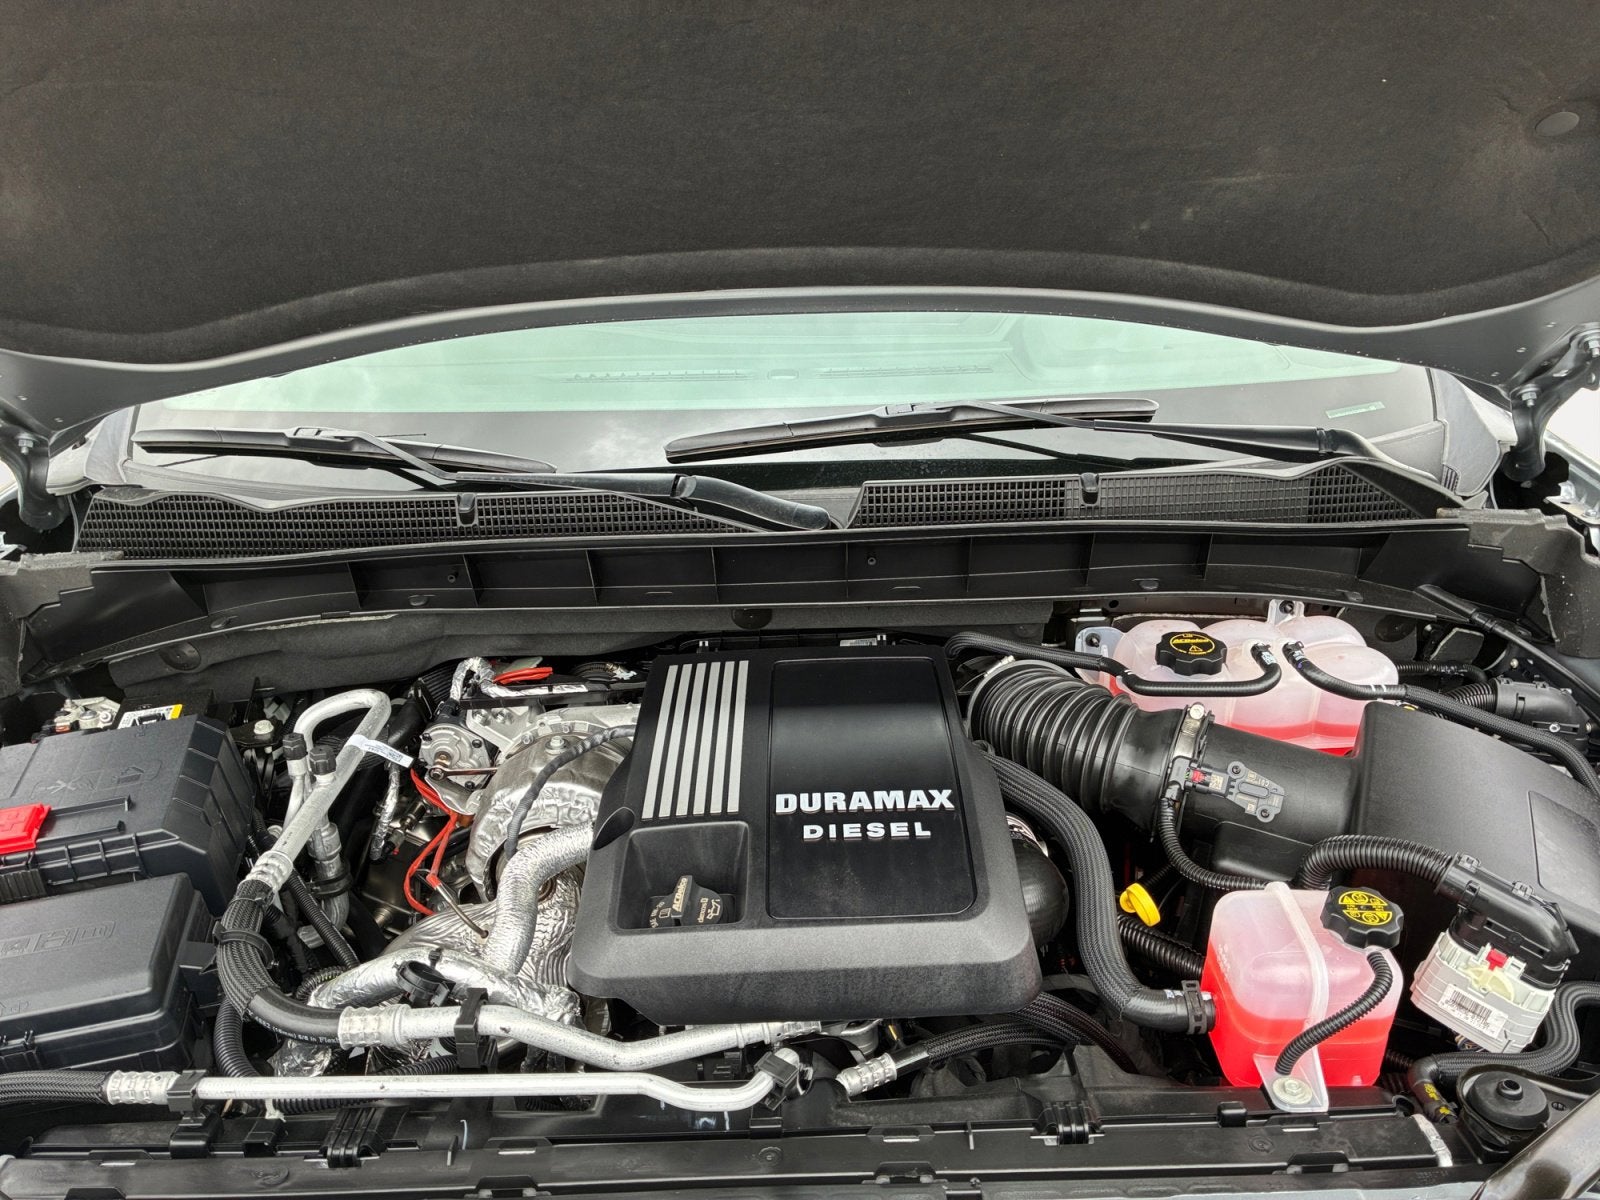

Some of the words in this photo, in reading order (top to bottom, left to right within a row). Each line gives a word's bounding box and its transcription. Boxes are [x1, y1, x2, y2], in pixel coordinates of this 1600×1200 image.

[775, 789, 955, 814] DURAMAX
[803, 822, 931, 841] DIESEL
[672, 877, 688, 913] ACDelco
